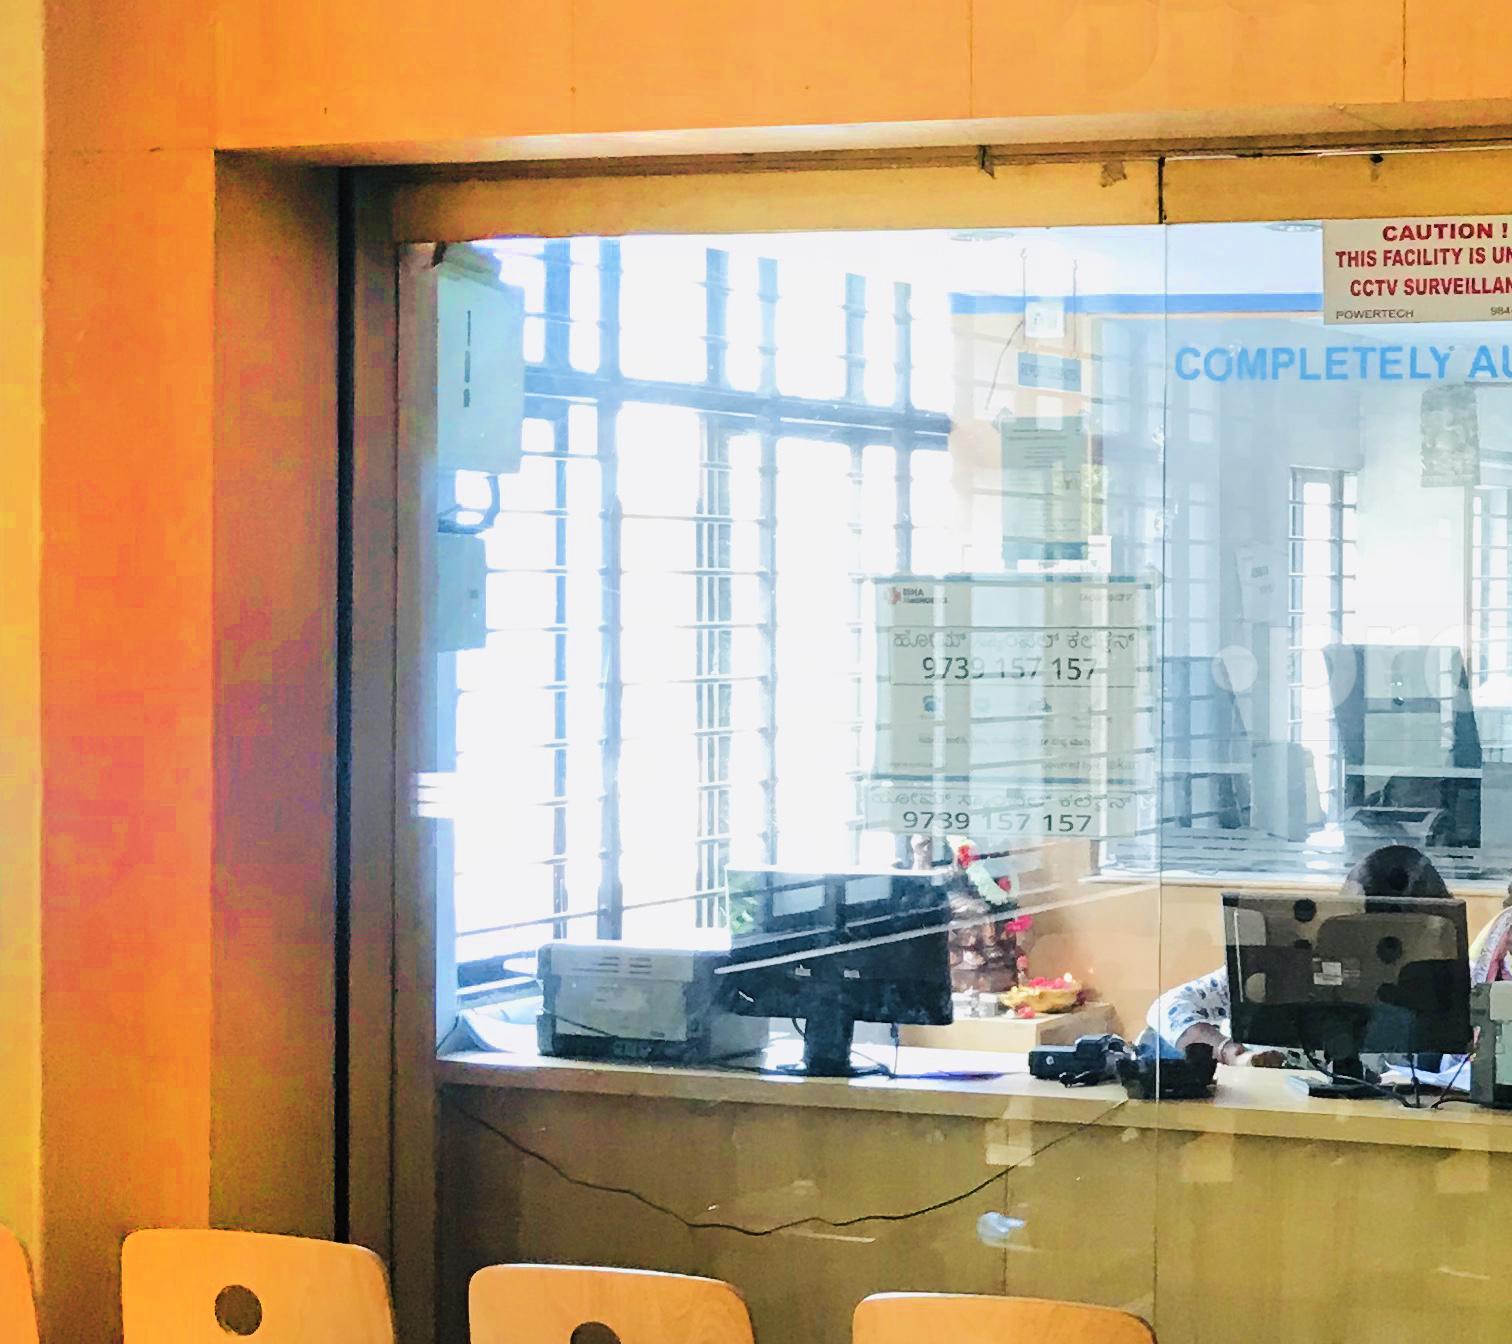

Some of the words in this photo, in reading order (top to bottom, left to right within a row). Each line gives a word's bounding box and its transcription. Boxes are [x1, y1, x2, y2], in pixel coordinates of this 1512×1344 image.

[1382, 223, 1493, 242] CAUTION
[1501, 223, 1509, 239] !
[1336, 250, 1377, 268] THIS
[1383, 248, 1463, 267] FACILITY
[1469, 247, 1486, 264] IS
[1350, 278, 1398, 297] CCTV
[1336, 309, 1414, 320] POWERTECH
[1174, 345, 1452, 382] COMPLETELY
[923, 656, 984, 679] 9739
[995, 657, 1042, 678] 157
[1051, 657, 1097, 681] 157
[903, 811, 970, 830] 9739
[982, 812, 1031, 831] 157
[1043, 814, 1093, 832] 157
